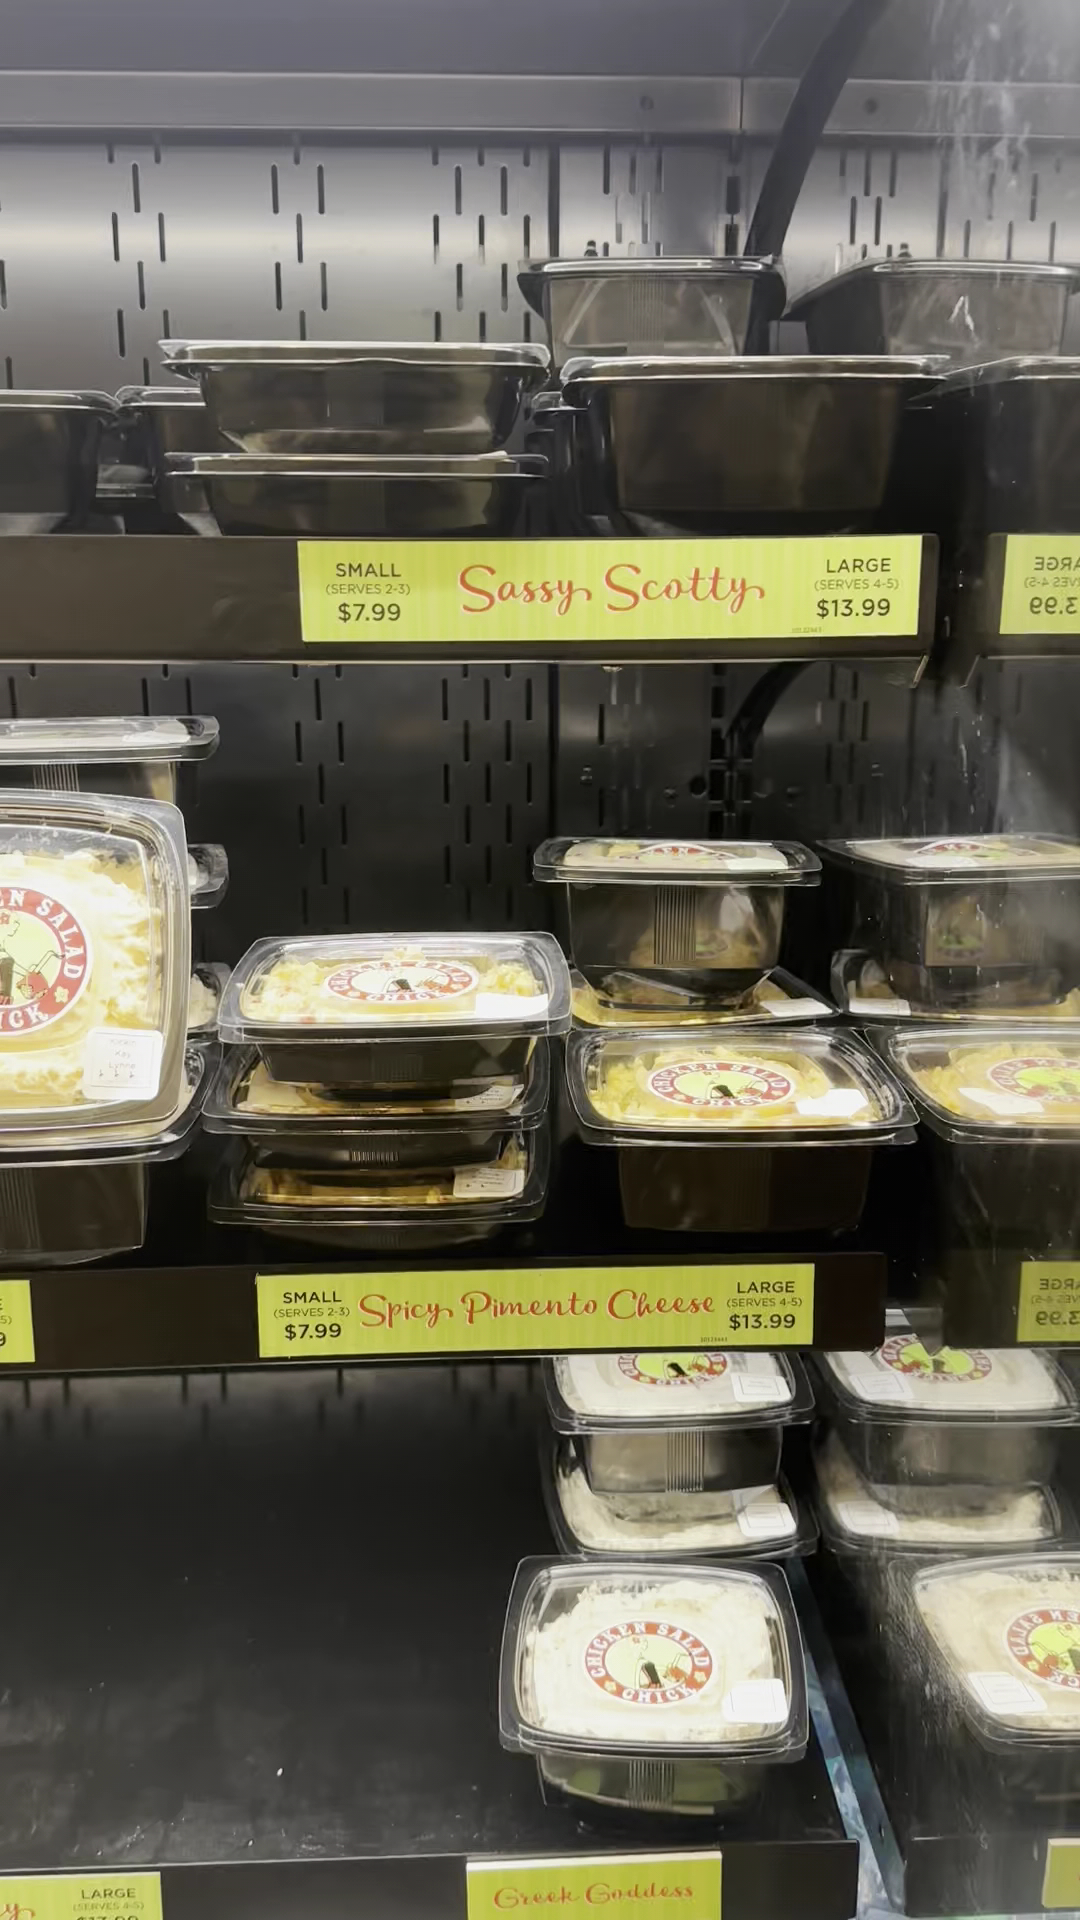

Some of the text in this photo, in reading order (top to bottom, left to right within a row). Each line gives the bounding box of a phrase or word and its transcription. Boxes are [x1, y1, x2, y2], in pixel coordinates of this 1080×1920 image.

[335, 563, 402, 578] SMALL
[826, 558, 892, 574] LARGE
[325, 583, 412, 596] (SERVES 2-3)
[458, 563, 766, 616] Sassy Scotty
[814, 578, 900, 592] (SERVES 4-5)
[337, 602, 401, 623] $7.99
[816, 598, 891, 620] $13.99
[36, 895, 85, 979] SALAD
[654, 1063, 717, 1093] CHICKEN
[737, 1281, 796, 1294] LARGE
[283, 1290, 342, 1304] SMALL
[726, 1297, 803, 1309] (SERVES 4-5)
[273, 1306, 351, 1319] (SERVES 2-3)
[357, 1288, 716, 1330] Spicy Pimento Cheese
[729, 1313, 796, 1331] $13.99
[284, 1323, 342, 1342] $7.99
[586, 1622, 711, 1679] CHICKEN SALAD
[621, 1684, 698, 1704] CHICK
[81, 1888, 136, 1900] LARGE
[493, 1882, 694, 1909] Greek Goddess
